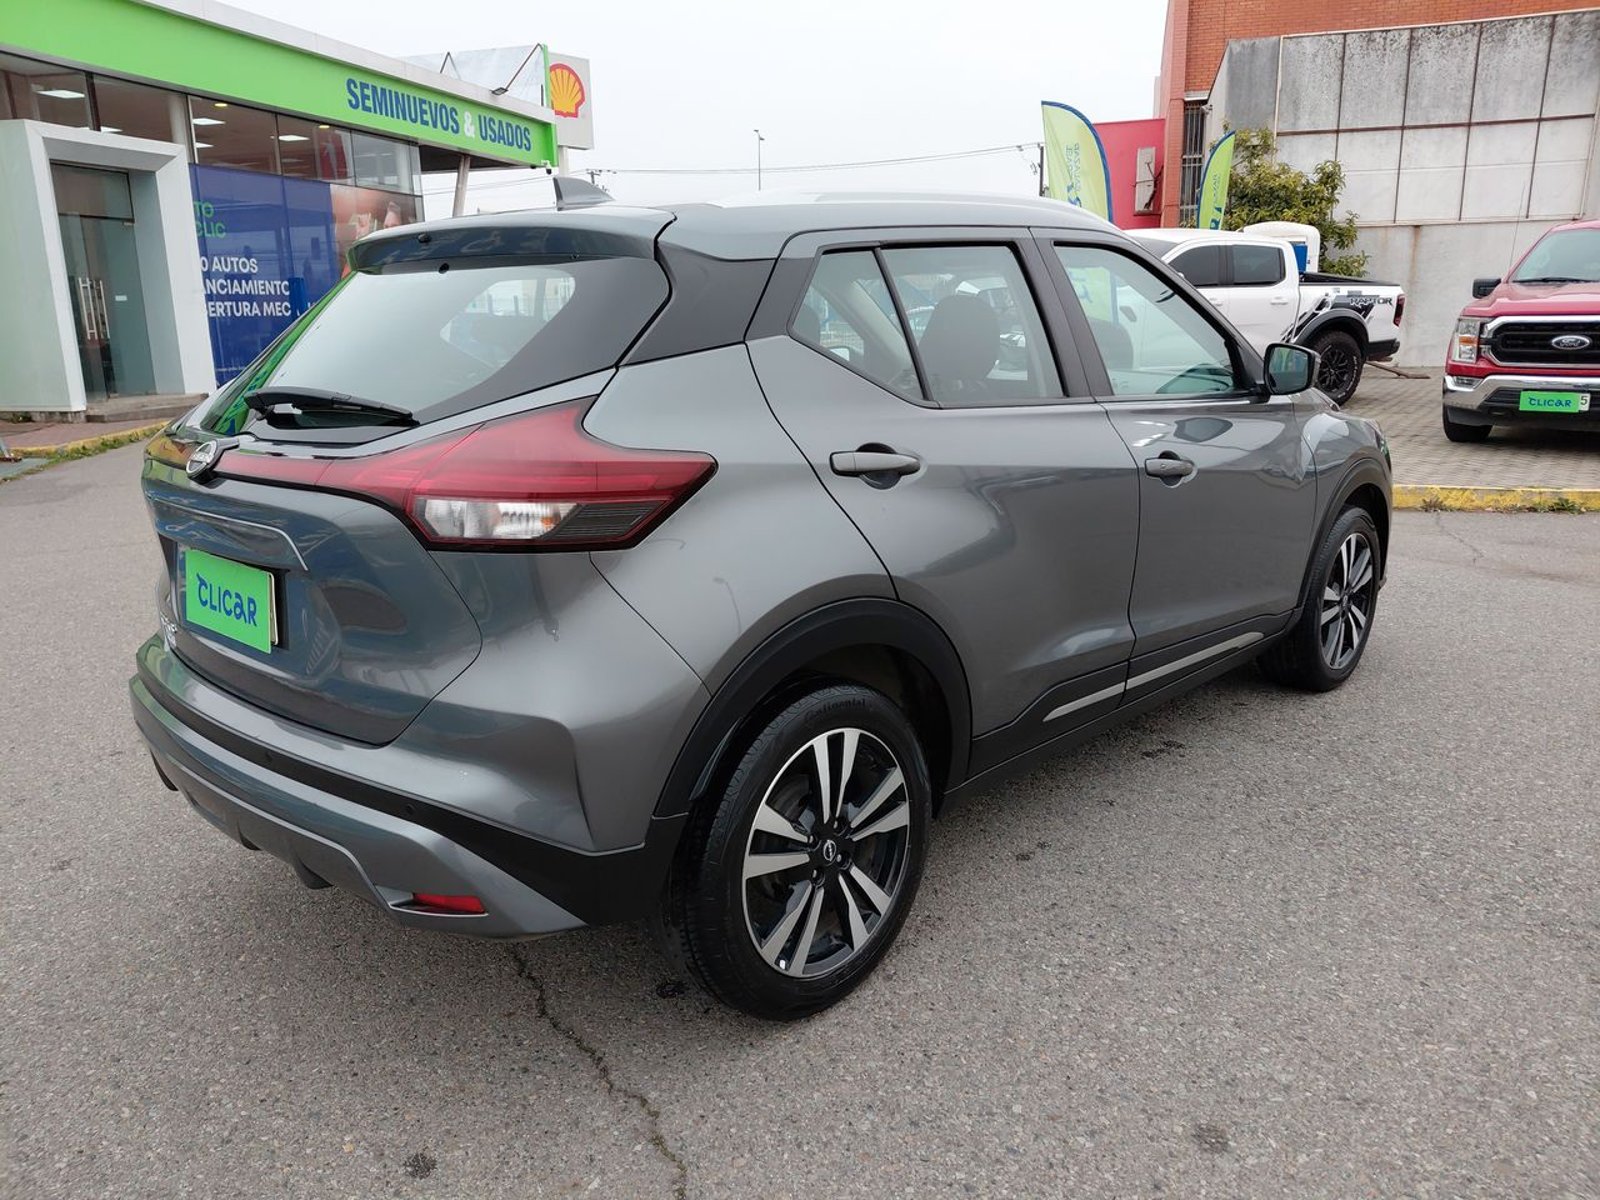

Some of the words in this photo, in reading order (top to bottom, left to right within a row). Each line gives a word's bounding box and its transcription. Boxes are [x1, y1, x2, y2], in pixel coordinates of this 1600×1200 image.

[346, 78, 460, 134] SEMINUEVOS
[463, 111, 476, 139] &
[478, 114, 532, 151] USADOS
[212, 256, 258, 274] AUTOS
[206, 301, 261, 317] ERTURA
[1580, 395, 1588, 406] 5
